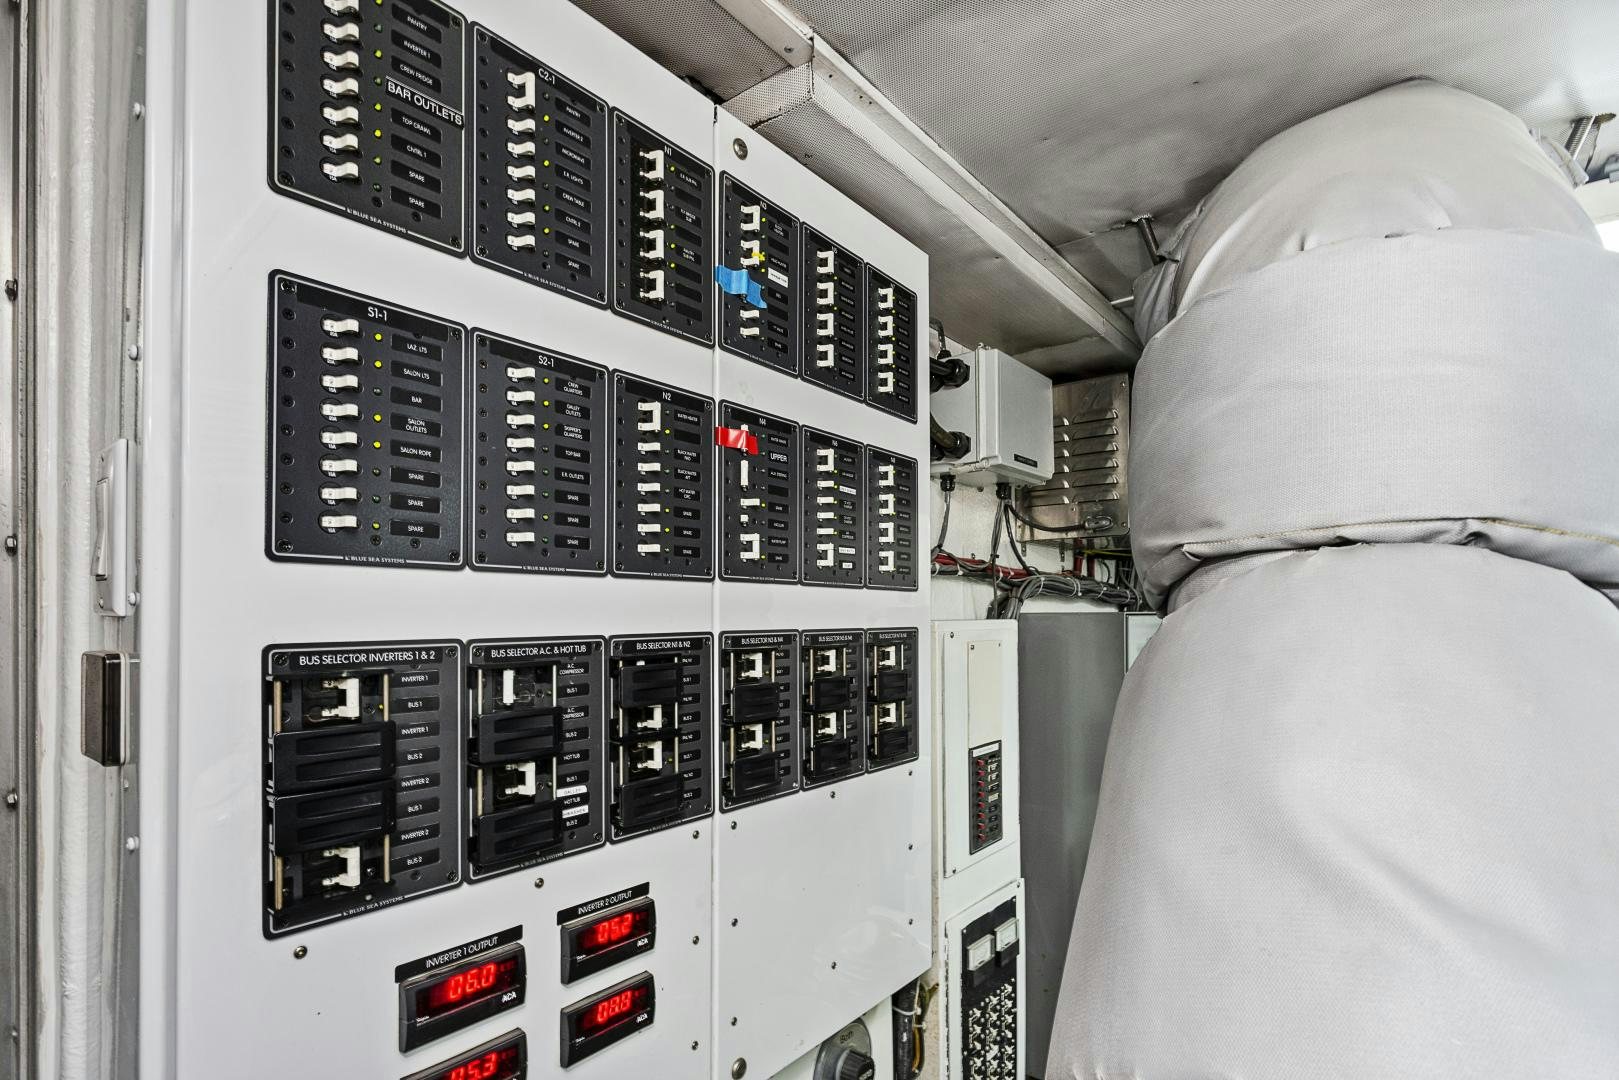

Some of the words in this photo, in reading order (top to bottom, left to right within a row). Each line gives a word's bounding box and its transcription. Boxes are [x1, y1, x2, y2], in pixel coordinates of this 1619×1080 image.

[408, 16, 427, 31] PANTRY
[404, 40, 427, 56] INVERTER
[538, 68, 556, 85] C2-1
[388, 81, 411, 101] BAR
[414, 94, 462, 126] OUTLETS
[402, 117, 412, 126] TOP
[408, 171, 424, 182] SPARE
[408, 197, 424, 208] SPARE
[353, 208, 370, 220] BLUE
[370, 216, 382, 225] SEA
[382, 220, 406, 234] SYSTEMS
[368, 306, 388, 322] S1-1
[538, 356, 554, 368] S2-1
[404, 368, 421, 379] SALON
[422, 372, 430, 380] LTS
[411, 396, 423, 404] BAR
[662, 392, 672, 400] N2
[407, 418, 425, 426] SALON
[406, 424, 428, 434] OUTLETS
[400, 446, 418, 456] SALON
[418, 450, 432, 458] ROPE
[770, 452, 788, 462] UPPER
[408, 473, 424, 482] SPARE
[408, 499, 424, 508] SPARE
[408, 525, 424, 533] SPARE
[492, 649, 506, 658] BUS
[506, 648, 538, 656] SELECTOR
[540, 647, 552, 655] A.C.
[560, 646, 574, 654] HOT
[574, 645, 586, 653] TUB
[300, 656, 320, 666] BUS
[322, 653, 367, 664] SELECTOR
[369, 652, 412, 662] INVERTERS
[421, 652, 428, 660] &
[430, 651, 436, 660] 2
[402, 778, 424, 788] INVERTER
[401, 831, 424, 840] INVERTER
[578, 900, 604, 914] INVERTER
[610, 891, 632, 904] OUTPUT
[350, 905, 365, 916] BLUE
[426, 949, 462, 968] INVERTER
[468, 936, 498, 954] OUTPUT
[502, 992, 517, 1002] ACA
